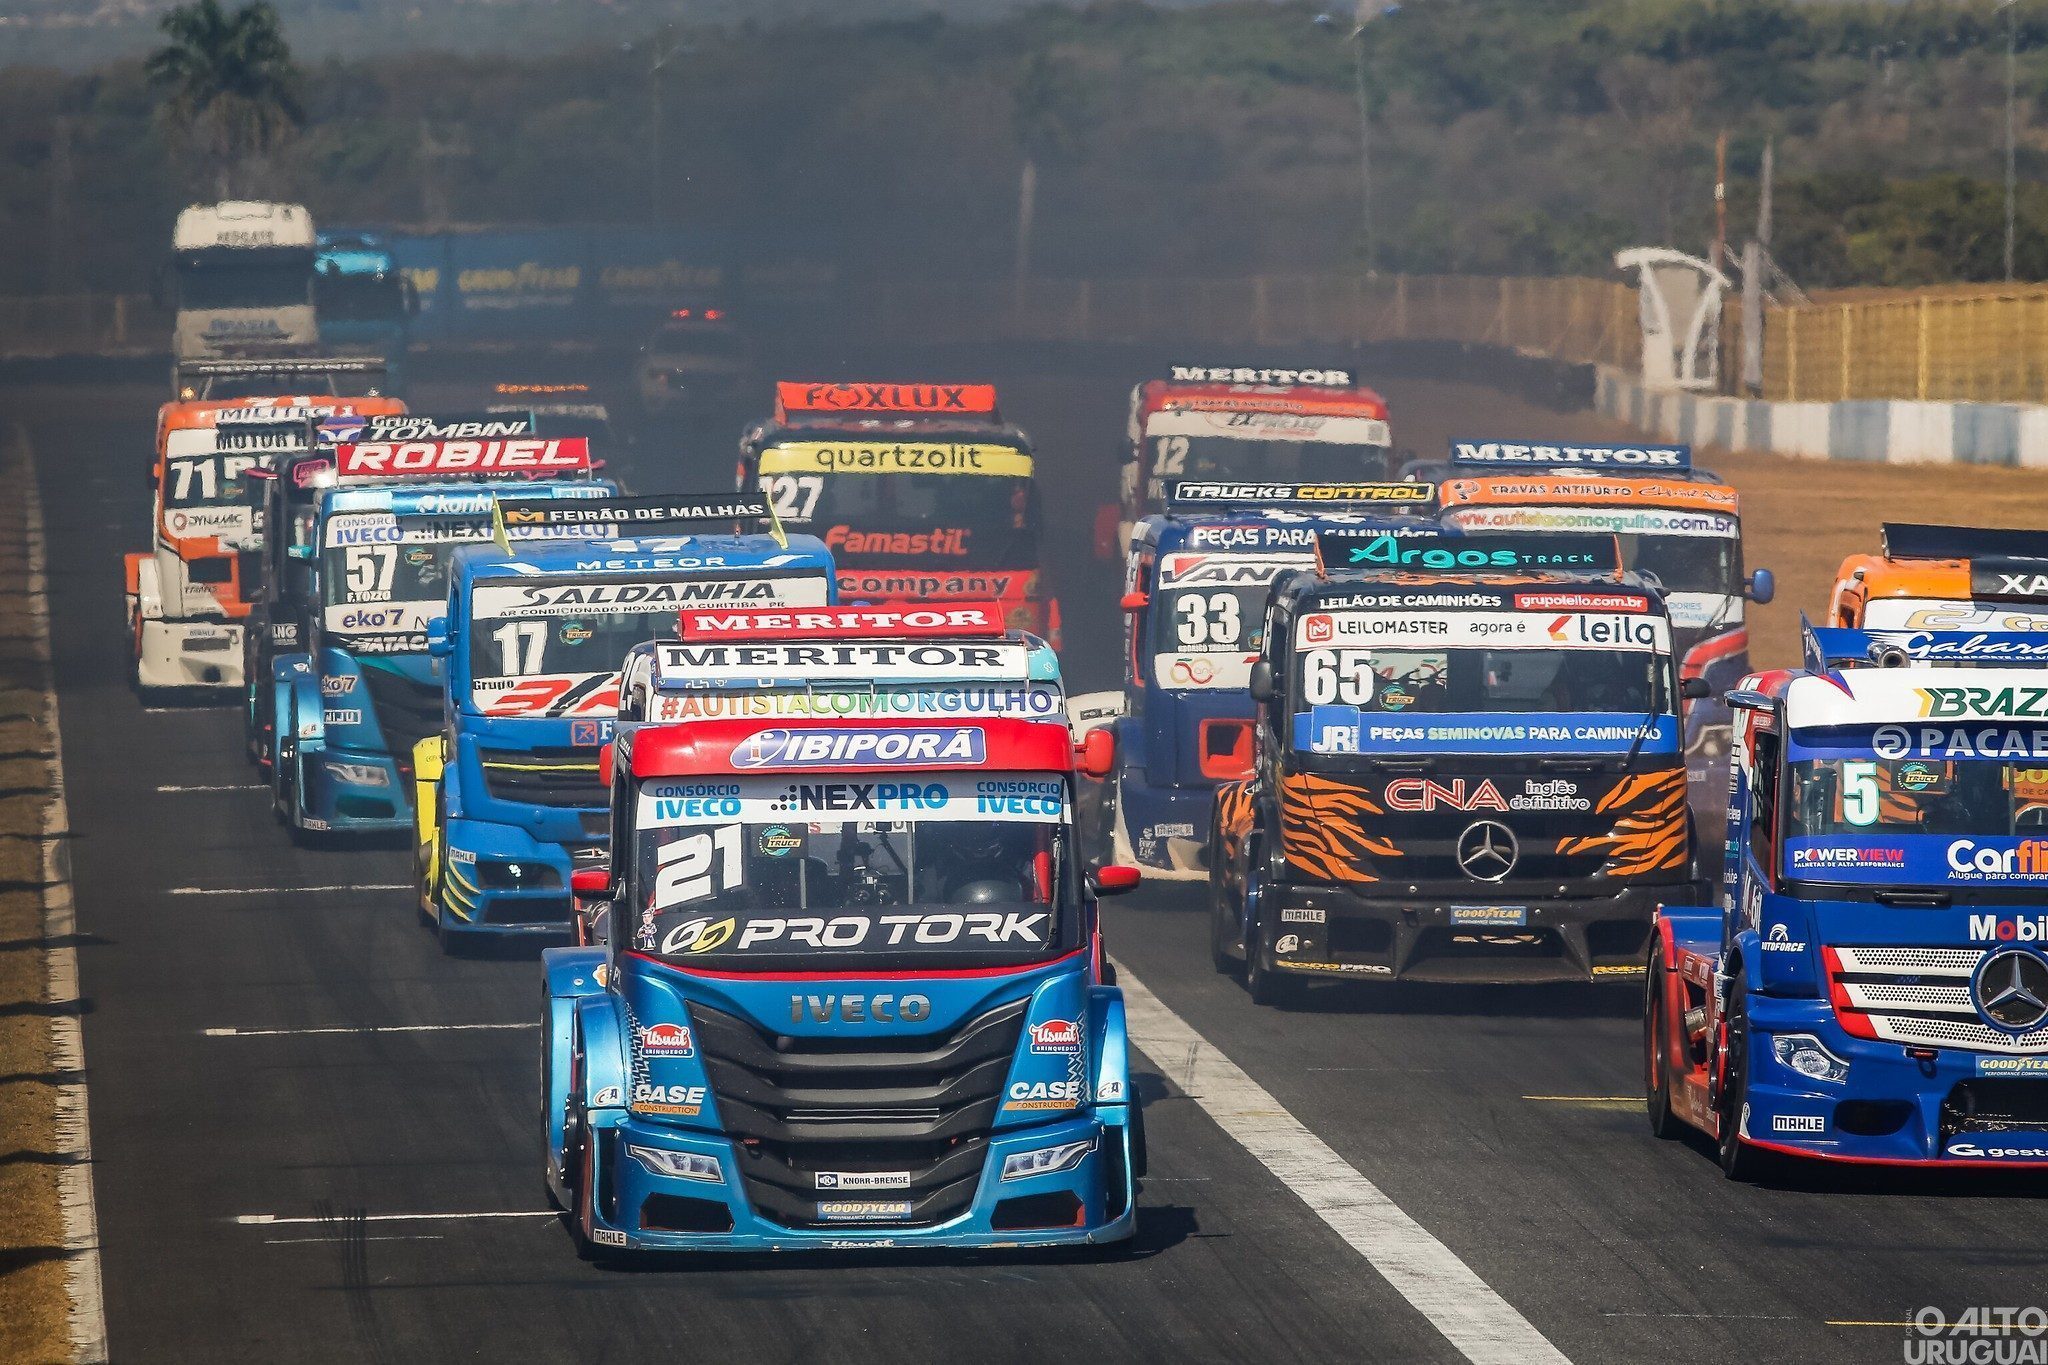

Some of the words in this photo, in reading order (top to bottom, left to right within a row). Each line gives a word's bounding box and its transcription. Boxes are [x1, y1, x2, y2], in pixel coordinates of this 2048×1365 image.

[1171, 366, 1350, 385] MERITOR
[806, 385, 966, 408] FOXLUX
[369, 421, 529, 441] TOMBINI
[370, 416, 432, 429] Grupo
[348, 441, 581, 470] ROBIEL
[816, 445, 982, 469] quartzolit
[1153, 437, 1189, 475] 12
[1456, 444, 1680, 465] MERITOR
[170, 459, 217, 499] 71
[1183, 487, 1292, 499] TRUCKS
[1297, 487, 1427, 500] CONTROL
[1491, 485, 1546, 496] TRAVAS
[1552, 485, 1631, 496] ANTIFURTO
[550, 505, 635, 523] FEIRÃO
[638, 508, 663, 519] DE
[671, 503, 764, 517] MALHAS
[337, 527, 404, 544] IVECO
[1193, 528, 1259, 549] PEÇAS
[1266, 529, 1316, 546] PARA
[1349, 535, 1518, 568] Argos
[1522, 552, 1594, 563] TRACK
[346, 544, 398, 592] 57
[576, 556, 726, 571] METEOR
[510, 583, 775, 609] SALDANHA
[837, 577, 1010, 597] company
[521, 607, 619, 616] CONDICIONADO
[623, 605, 658, 613] NOVA
[698, 601, 758, 610] CURITIBA
[1319, 595, 1378, 609] LEILÃO
[1380, 595, 1401, 606] DE
[1404, 594, 1501, 607] CAMINHÕES
[343, 608, 404, 628] eko'7
[694, 609, 990, 632] MERITOR
[1177, 593, 1240, 644] 33
[1338, 621, 1448, 634] LEILOMASTER
[1470, 622, 1512, 637] agora
[1517, 620, 1526, 632] é
[1580, 615, 1655, 645] leilo
[493, 621, 548, 676] 17
[666, 646, 1005, 668] MERITOR
[473, 678, 515, 692] Grupo
[1304, 650, 1375, 705] 65
[660, 690, 1053, 720] #AUTISTACOMORGULHO
[1912, 688, 2048, 717] BRAZ
[1312, 726, 1350, 752] JR
[1370, 727, 1424, 742] PEÇAS
[1428, 726, 1526, 740] SEMINOVAS
[1529, 726, 1570, 740] PARA
[1575, 724, 1662, 741] CAMINHÃO
[784, 729, 973, 761] IBIPORÃ
[655, 782, 741, 798] CONSÓRCIO
[800, 783, 949, 811] NEXPRO
[976, 780, 1061, 795] CONSÓRCIO
[1385, 778, 1509, 812] CNA
[1526, 779, 1577, 796] inglês
[1843, 761, 1880, 826] 5
[655, 797, 742, 819] IVECO
[976, 794, 1062, 816] IVECO
[1510, 795, 1591, 811] definitivo
[769, 839, 801, 848] TRUCK
[451, 848, 475, 863] MAHLE
[1794, 848, 1904, 862] POWERVIEW
[654, 823, 744, 911] 21
[1948, 871, 1983, 881] Alugue
[1986, 872, 2007, 881] para
[1284, 910, 1323, 922] MAHLE
[1454, 906, 1521, 919] GOODYEAR
[736, 915, 871, 950] PRO
[879, 913, 1051, 944] TORK
[791, 994, 931, 1024] IVECO
[642, 1028, 688, 1046] Usual
[1031, 1023, 1078, 1043] Usual
[636, 1084, 706, 1104] CASE
[1010, 1082, 1080, 1099] CASE
[639, 1105, 698, 1114] CONSTRUCTION
[1016, 1101, 1075, 1109] CONSTRUCTION
[1775, 1117, 1823, 1130] MAHLE
[1988, 1149, 2048, 1158] gest
[822, 1203, 906, 1214] GOODYEAR
[594, 1231, 625, 1245] MAHLE
